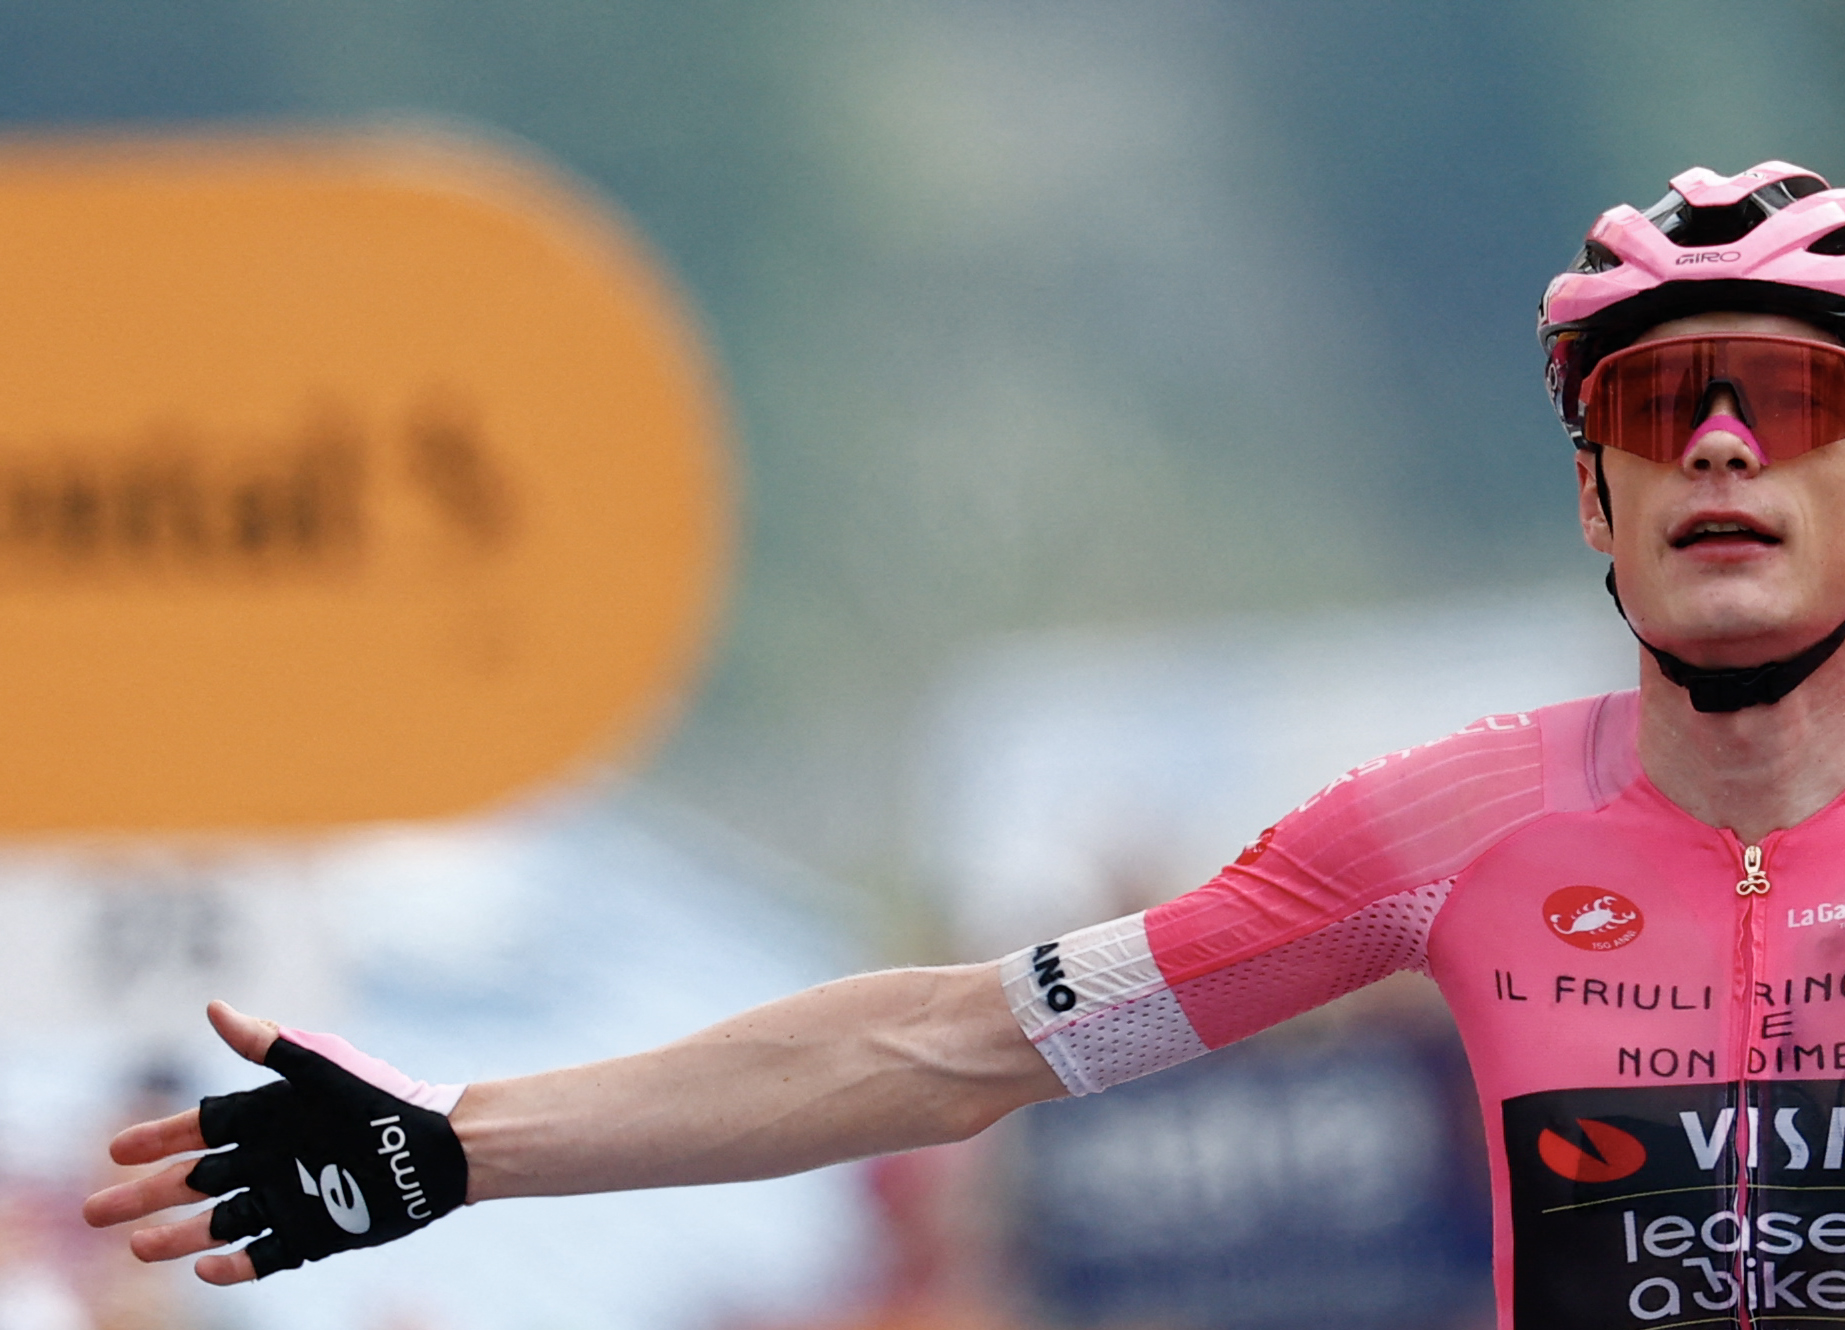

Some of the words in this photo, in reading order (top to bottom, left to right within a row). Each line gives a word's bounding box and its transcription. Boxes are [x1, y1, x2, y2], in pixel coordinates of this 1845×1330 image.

[1675, 251, 1741, 265] GIRO
[1299, 712, 1531, 813] ASLLI
[1787, 908, 1814, 928] La
[1495, 969, 1528, 1001] IL
[1556, 975, 1712, 1010] FRIULI
[1761, 1011, 1793, 1039] E
[1618, 1047, 1716, 1078] NON
[370, 1115, 432, 1220] nimbl
